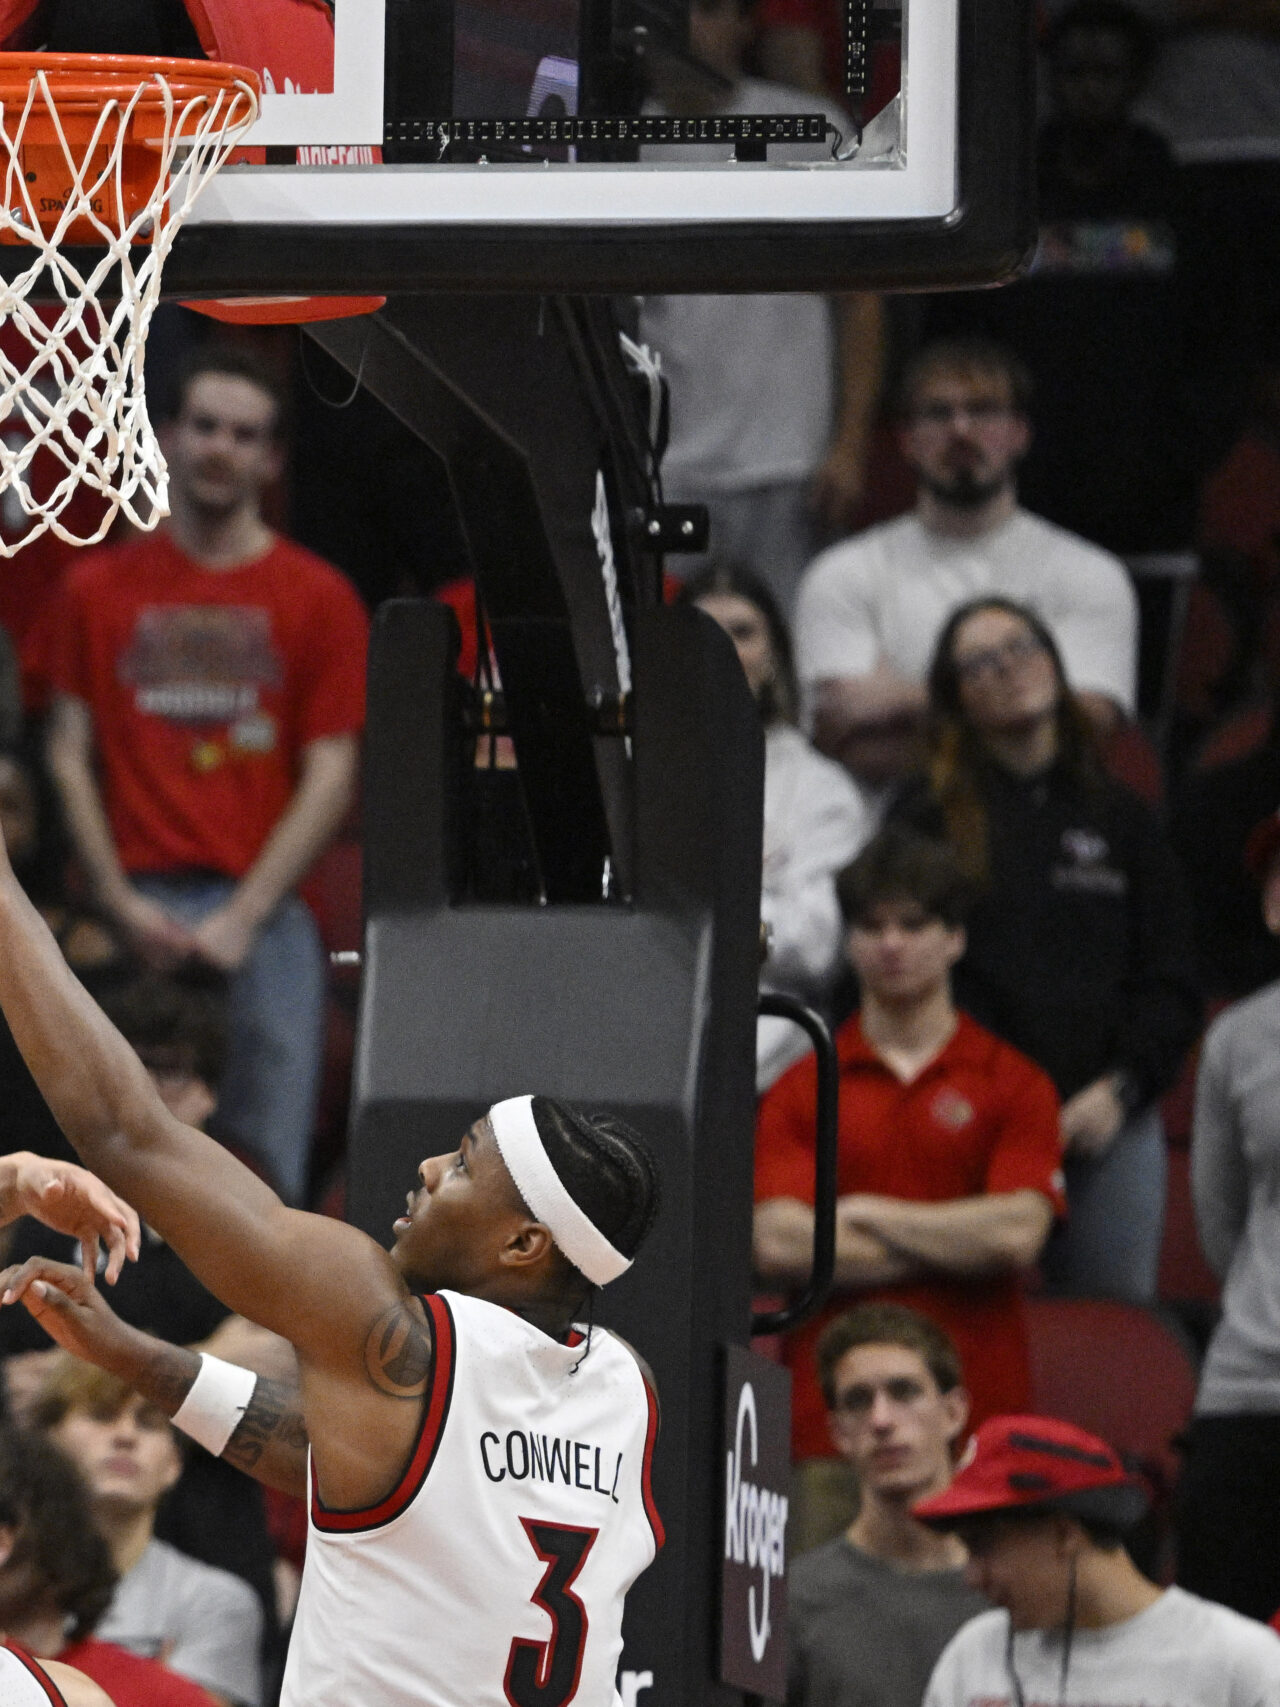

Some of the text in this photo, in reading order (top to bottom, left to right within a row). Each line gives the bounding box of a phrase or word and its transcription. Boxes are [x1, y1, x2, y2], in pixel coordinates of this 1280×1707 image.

[479, 1430, 623, 1505] CONWELL
[724, 1381, 789, 1664] Kroger
[502, 1515, 601, 1707] 3
